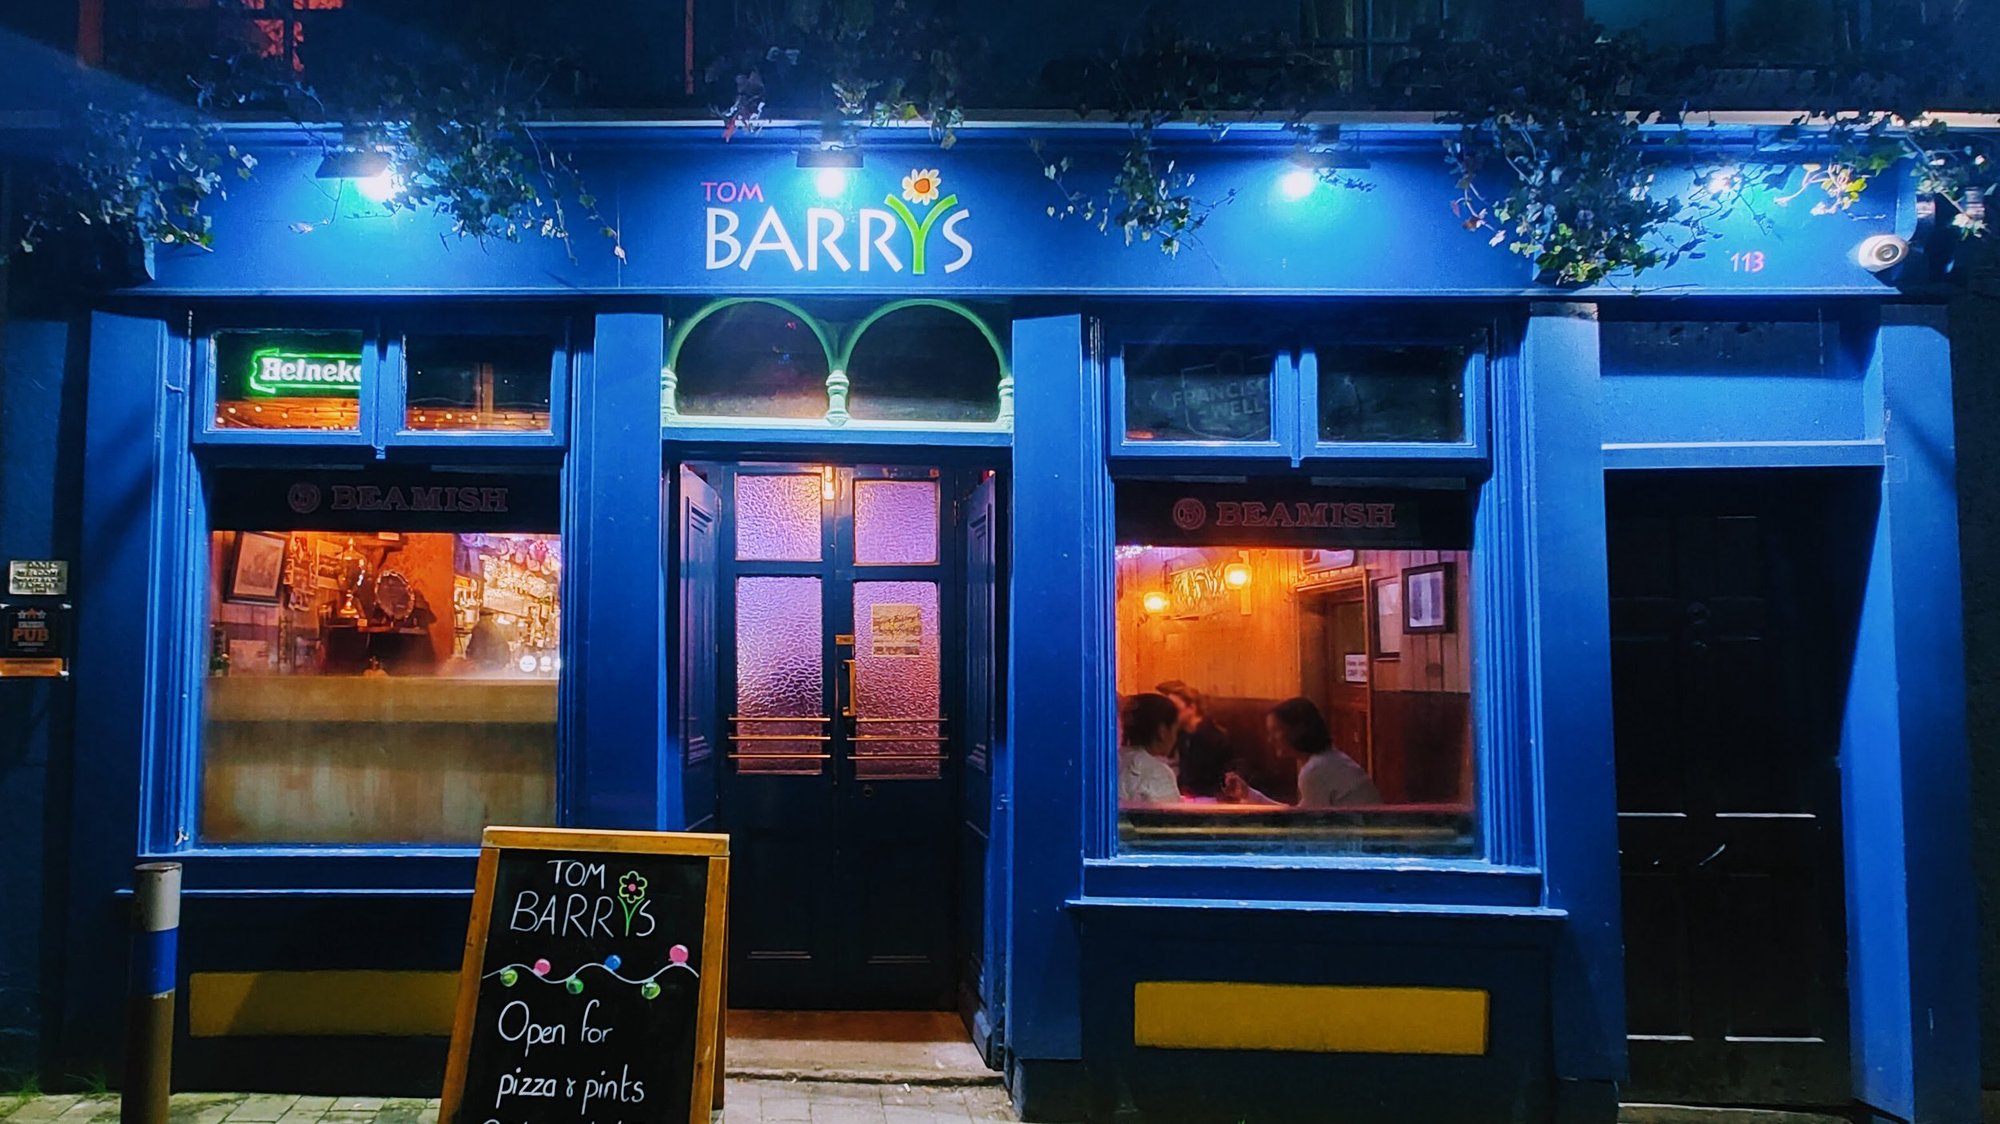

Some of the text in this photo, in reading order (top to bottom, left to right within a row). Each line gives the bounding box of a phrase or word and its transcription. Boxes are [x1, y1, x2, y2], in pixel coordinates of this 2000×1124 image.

[701, 181, 764, 203] TOM
[706, 194, 973, 275] BARRYS
[1730, 251, 1764, 273] 113
[331, 485, 509, 513] BEAMISH
[1216, 502, 1396, 528] BEAMISH
[12, 628, 50, 642] PUB
[547, 859, 605, 890] TOM
[510, 890, 656, 938] BARRYS
[498, 999, 613, 1057] Open for
[495, 1066, 557, 1109] pizza
[581, 1063, 645, 1115] pints
